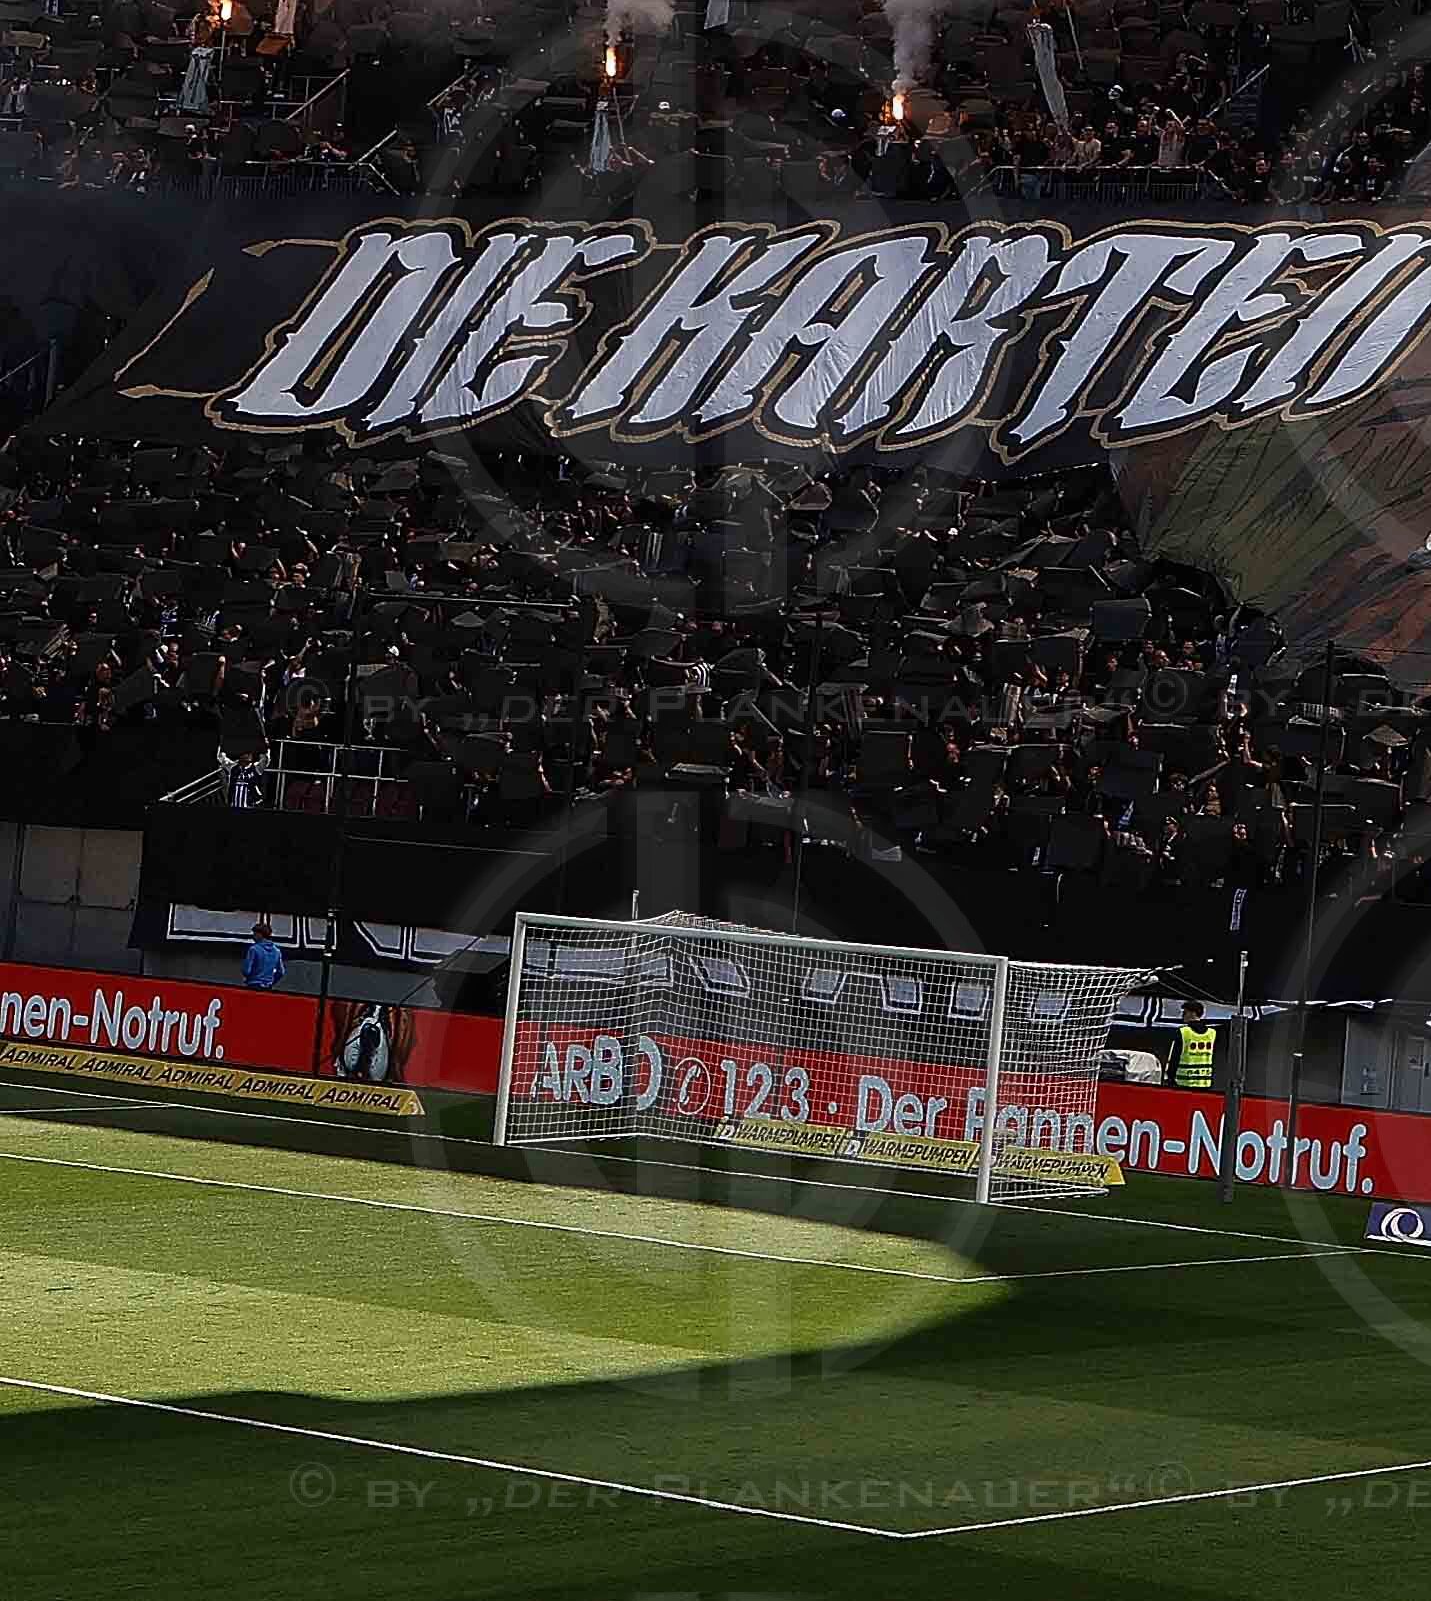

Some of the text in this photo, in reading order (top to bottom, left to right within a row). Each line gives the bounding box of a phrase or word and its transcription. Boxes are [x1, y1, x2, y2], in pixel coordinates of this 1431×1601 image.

[235, 227, 650, 427] DIE
[1, 1047, 76, 1071] ADMIRAL
[79, 1055, 153, 1082] ADMIRAL
[155, 1066, 236, 1091] ADMIRAL
[239, 1076, 315, 1101] ADMIRAL
[319, 1086, 404, 1111] ADMIRAL
[857, 1073, 948, 1137] Der
